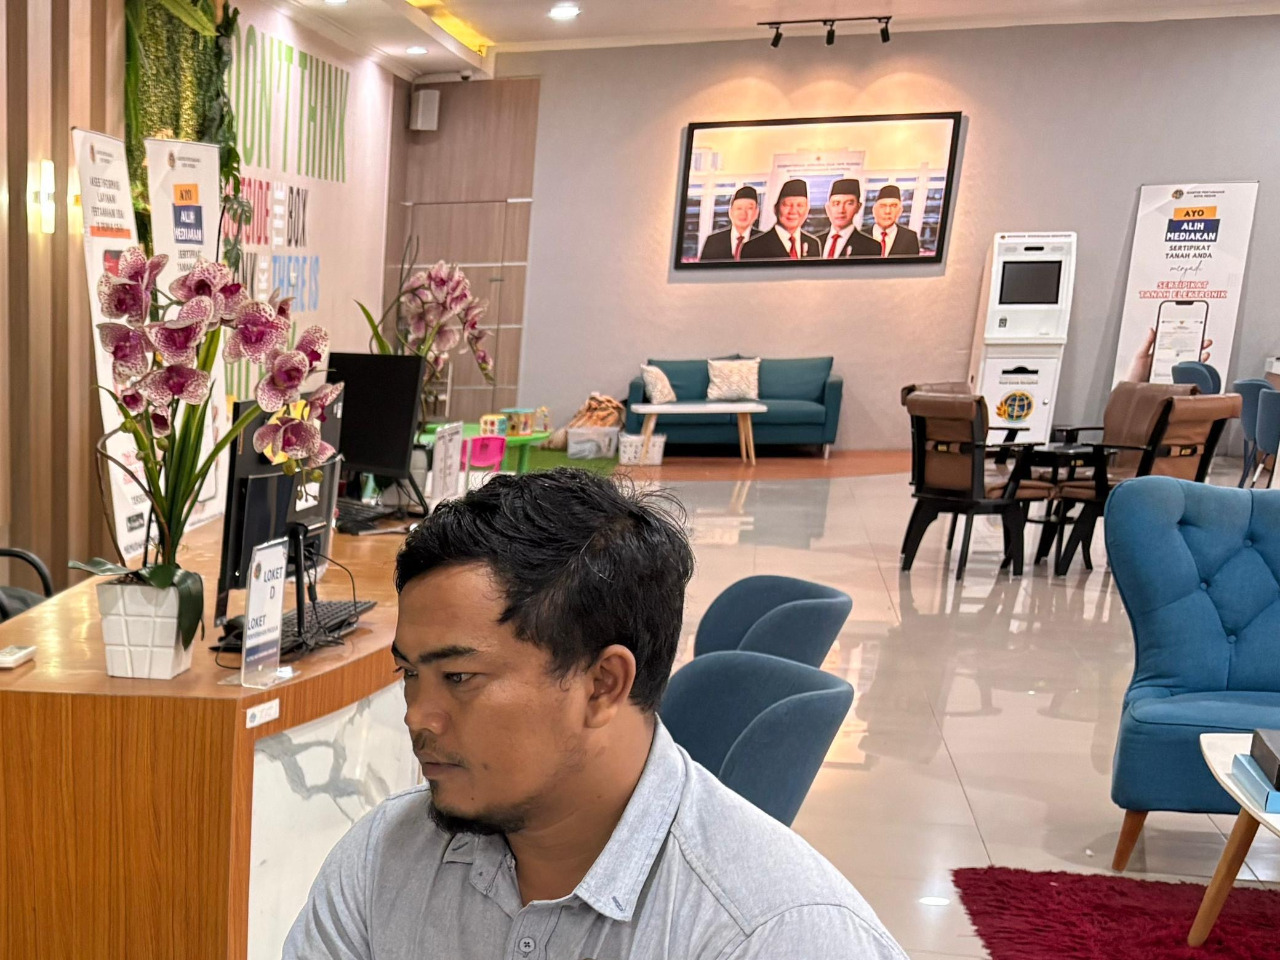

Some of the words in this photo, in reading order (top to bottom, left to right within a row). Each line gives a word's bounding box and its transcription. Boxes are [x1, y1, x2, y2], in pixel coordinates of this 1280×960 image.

[298, 50, 350, 184] THINK
[287, 186, 308, 248] BOX
[1183, 209, 1205, 218] AYO
[1181, 222, 1205, 230] ALIH
[1166, 232, 1217, 240] MEDIAKAN
[308, 255, 319, 312] IS
[1157, 281, 1209, 289] SERTIPIKAT
[1139, 291, 1170, 299] TANAH
[1172, 290, 1228, 299] ELEKTRONIK
[263, 566, 283, 582] LOKET
[270, 585, 275, 599] D
[247, 614, 267, 631] LOKET
